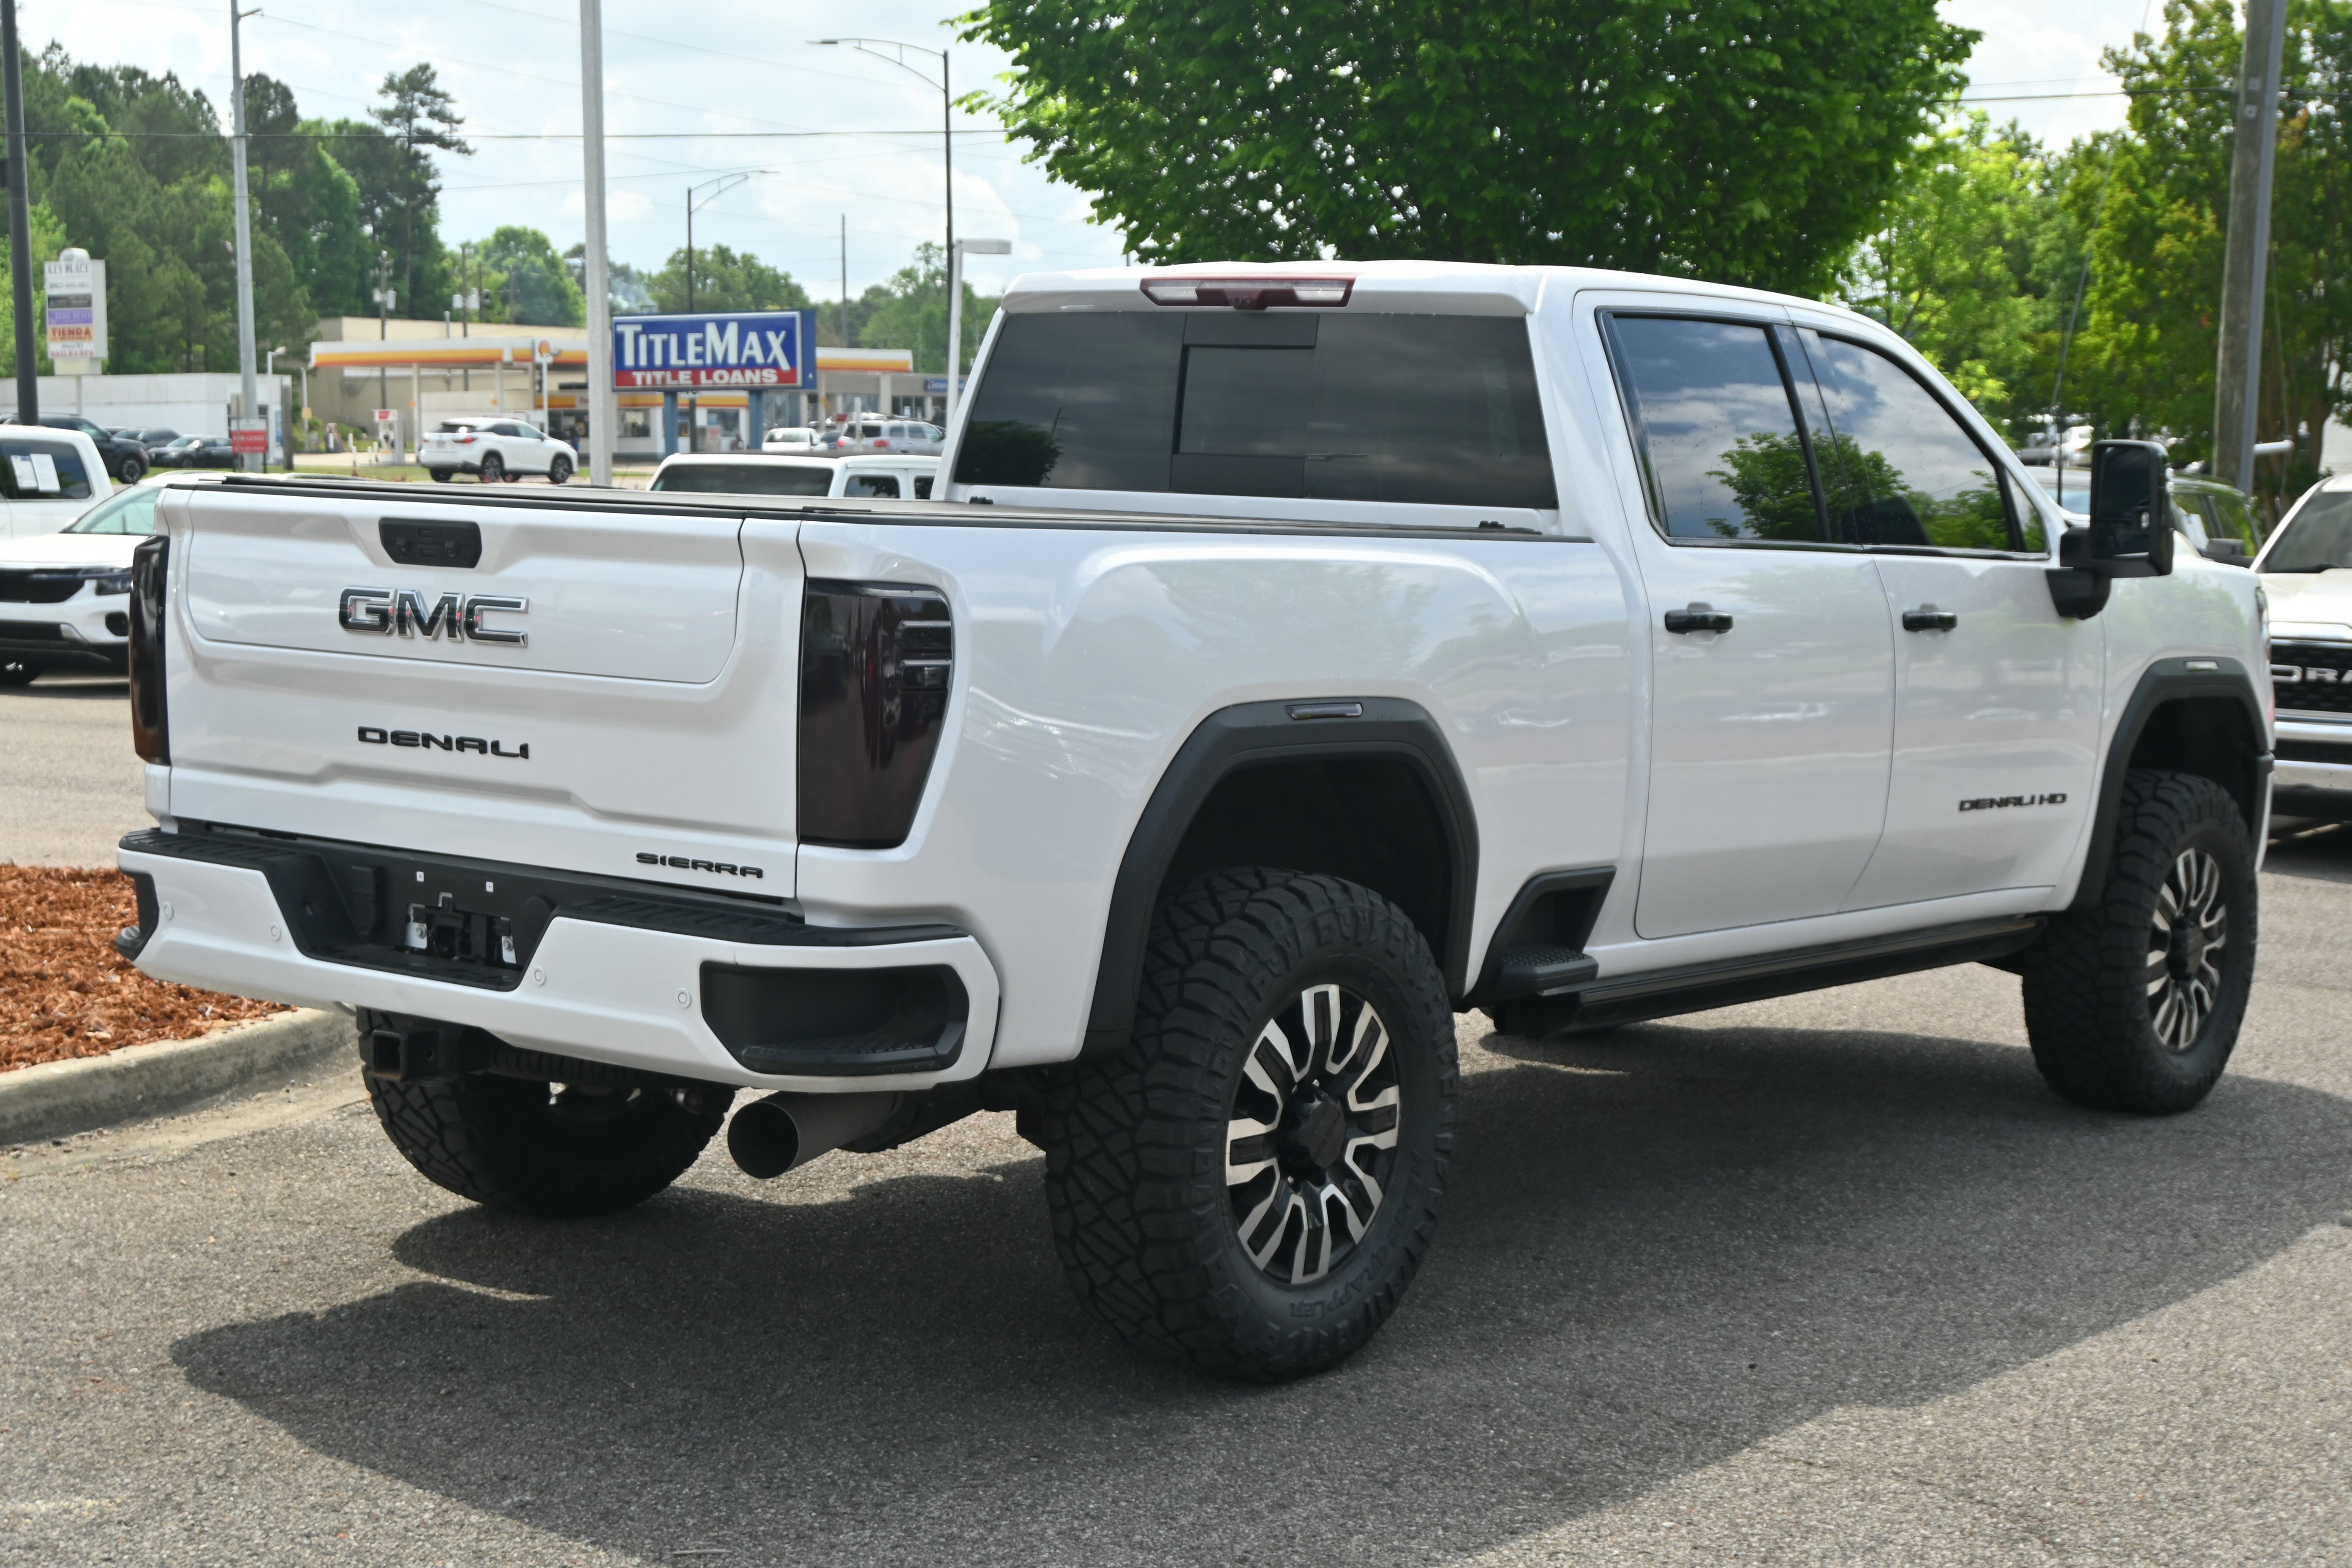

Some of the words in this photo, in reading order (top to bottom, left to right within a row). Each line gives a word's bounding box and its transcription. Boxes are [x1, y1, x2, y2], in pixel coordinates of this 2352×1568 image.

[48, 264, 63, 274] KEY
[65, 263, 90, 273] PLACE
[51, 327, 92, 336] TIENDA
[632, 370, 692, 386] TITLE
[700, 368, 778, 385] LOANS
[338, 585, 529, 647] GMC
[358, 726, 529, 759] DENALI
[1960, 794, 2036, 811] DENALI
[2039, 793, 2067, 805] HD
[636, 852, 763, 878] SIERRA
